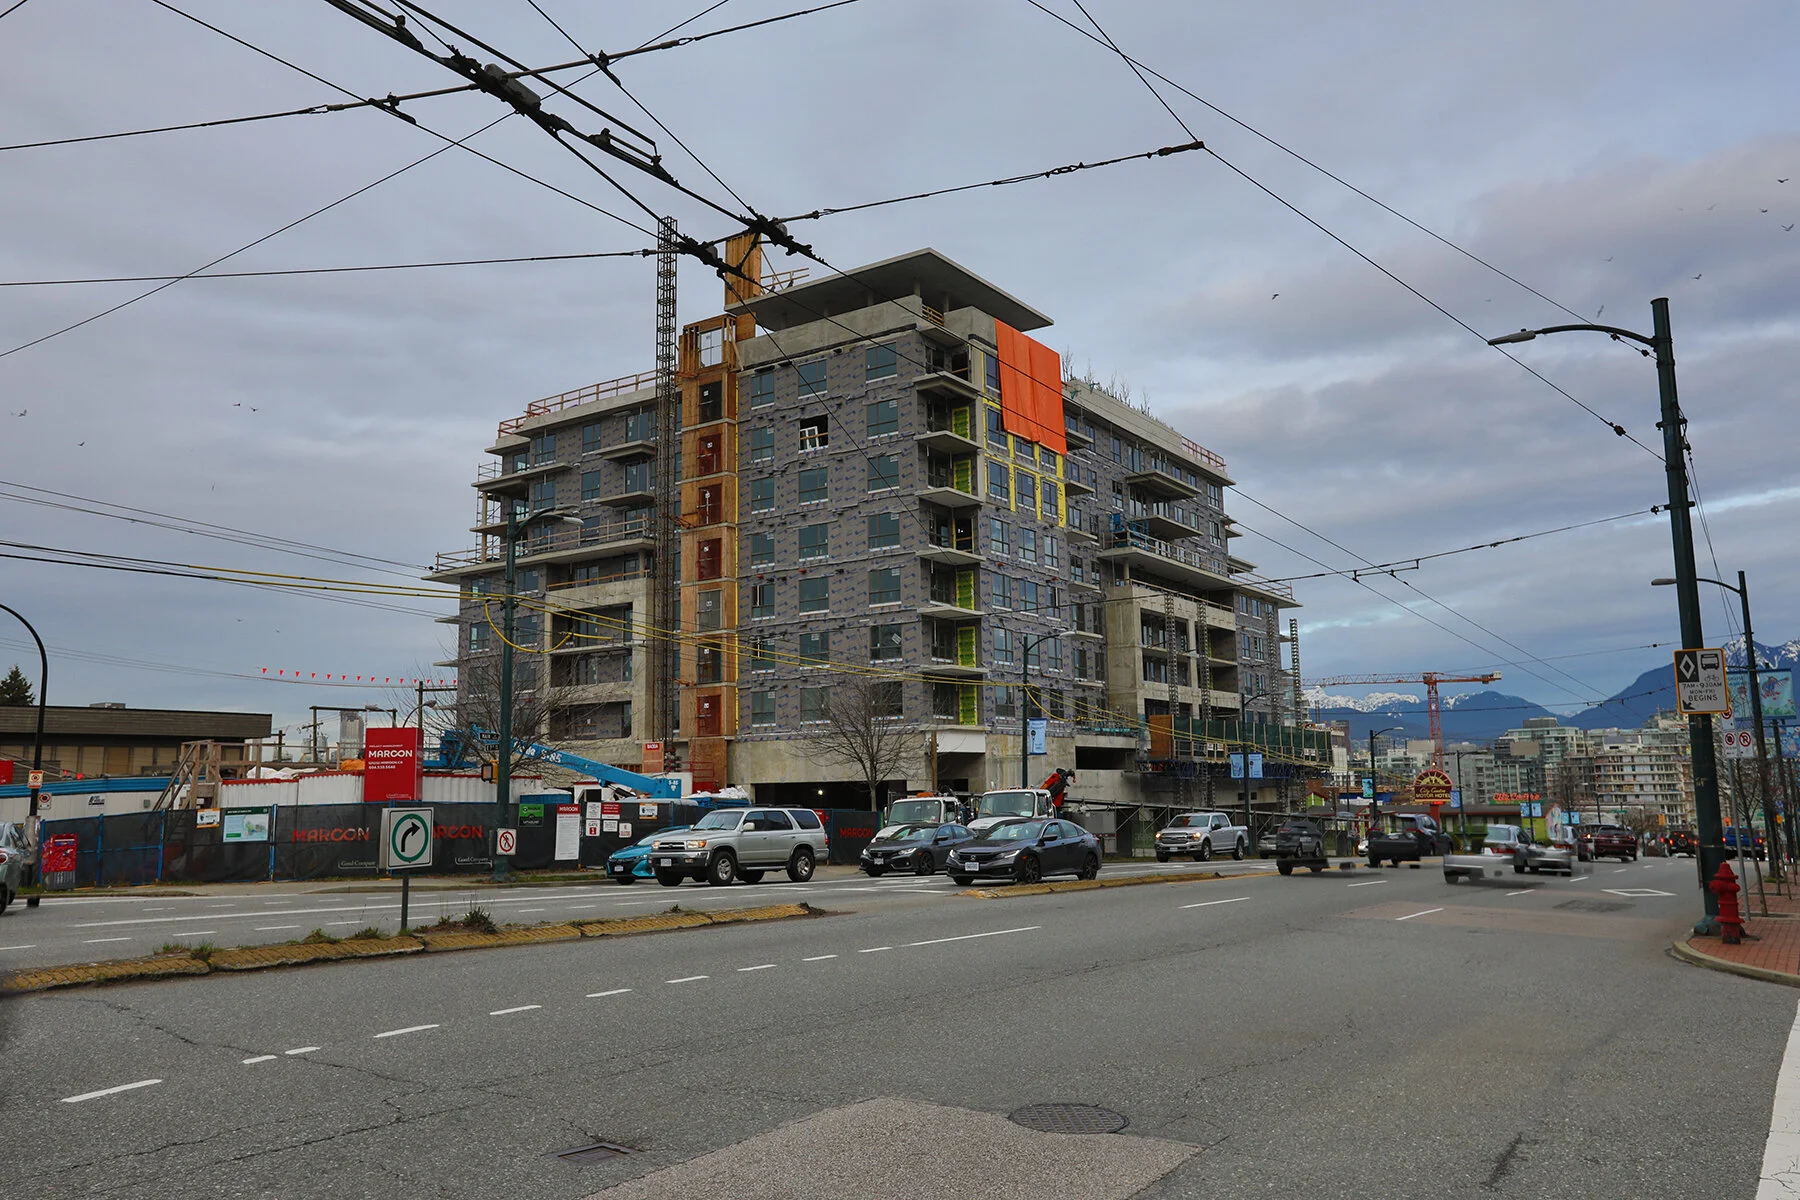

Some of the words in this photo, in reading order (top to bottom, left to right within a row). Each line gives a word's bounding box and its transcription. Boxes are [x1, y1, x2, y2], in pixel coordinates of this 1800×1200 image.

[368, 750, 413, 758] MARCON
[292, 827, 370, 843] MARCON
[840, 827, 873, 838] MARCON
